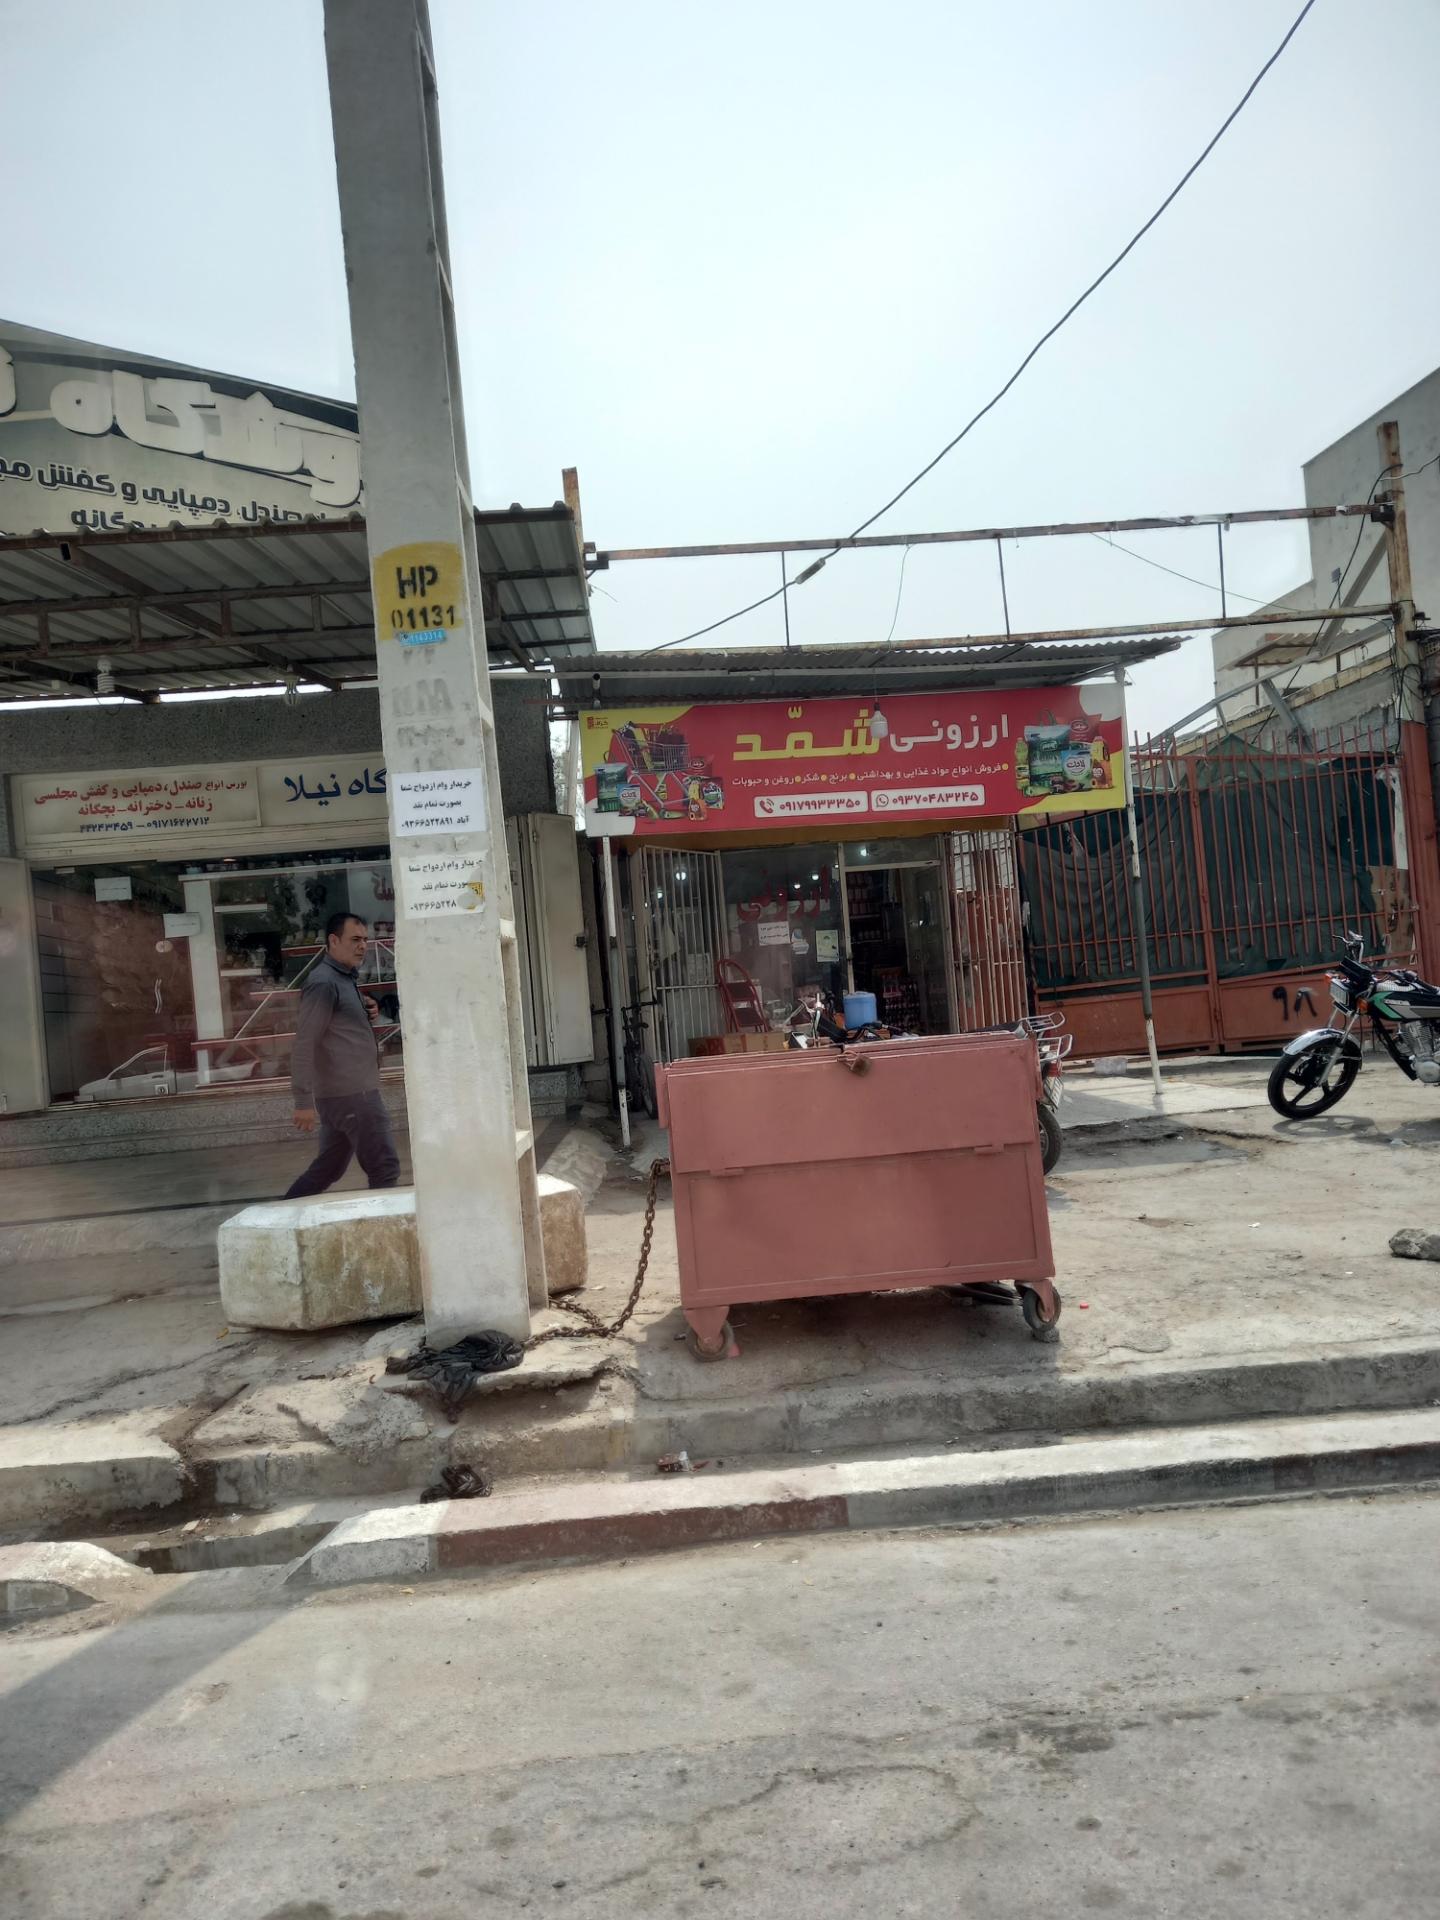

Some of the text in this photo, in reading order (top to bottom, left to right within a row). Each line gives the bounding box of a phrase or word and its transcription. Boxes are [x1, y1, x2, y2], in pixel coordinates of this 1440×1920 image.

[37, 463, 116, 494] کفش
[121, 481, 137, 501] و
[142, 486, 231, 516] دمپایی
[396, 565, 438, 599] HP
[391, 604, 456, 629] 01131
[889, 713, 1009, 752] ارزونی
[857, 770, 894, 781] بهداشتی
[903, 767, 929, 779] غذایی
[931, 765, 949, 777] مواد
[951, 765, 972, 778] انواع
[975, 763, 1001, 775] فروش
[205, 780, 224, 791] انواع
[225, 780, 247, 790] بورس
[732, 776, 762, 786] حبوبات
[771, 777, 794, 786] روغن
[802, 773, 820, 785] شکر
[828, 774, 848, 785] برنج
[34, 787, 78, 805] مجلسی
[80, 784, 110, 801] کفش
[111, 787, 119, 799] و
[121, 782, 162, 799] دمپایی
[283, 773, 343, 806] نیلا
[892, 791, 979, 805] ۰۹۳۷۰۴۸۳۲۴۵
[78, 796, 213, 819] زنانه دخترانه بچگانه
[779, 799, 861, 812] ۰۹۱۷۹۹۳۳۳۵۰
